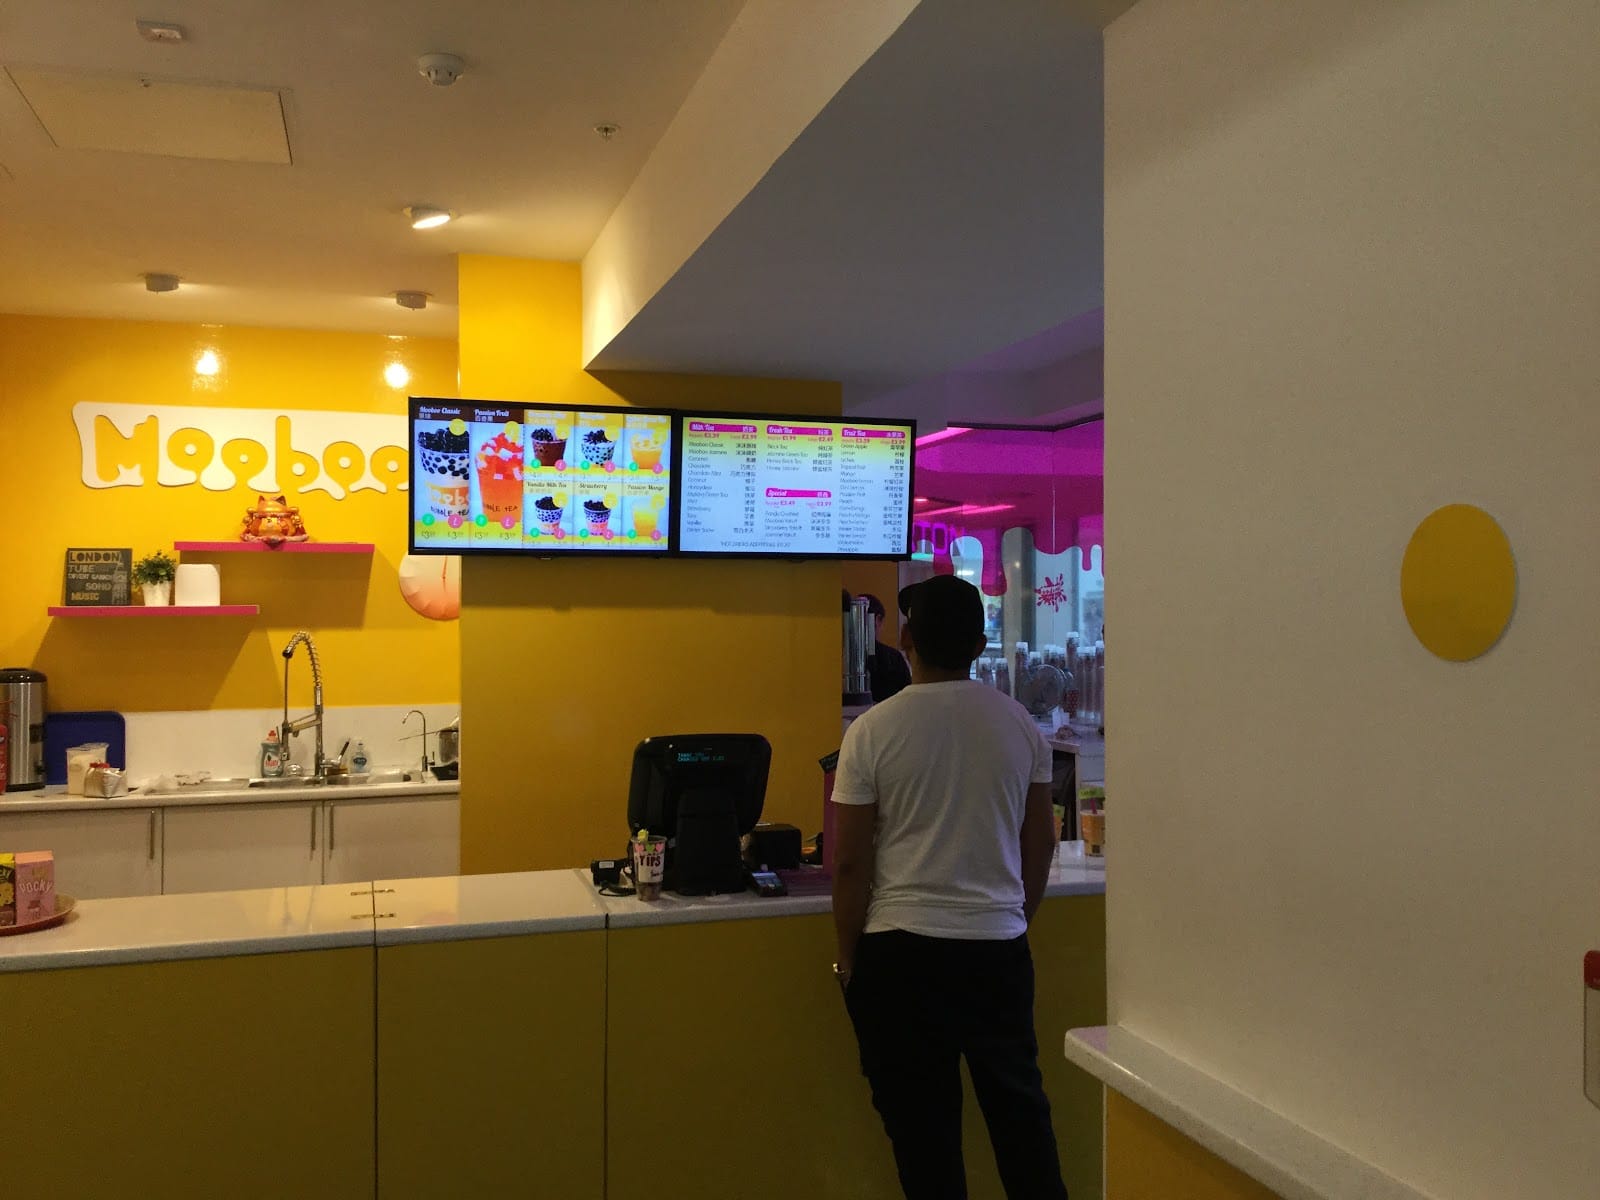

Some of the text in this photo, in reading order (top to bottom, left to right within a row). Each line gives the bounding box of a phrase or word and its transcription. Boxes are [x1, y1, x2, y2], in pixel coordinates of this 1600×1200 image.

[441, 407, 461, 415] Classic
[94, 414, 410, 494] Mooboo
[579, 483, 608, 491] Strawberry
[767, 489, 788, 497] Special
[70, 552, 121, 563] LONDON
[86, 582, 112, 591] SOHO
[71, 592, 100, 601] MUSIC
